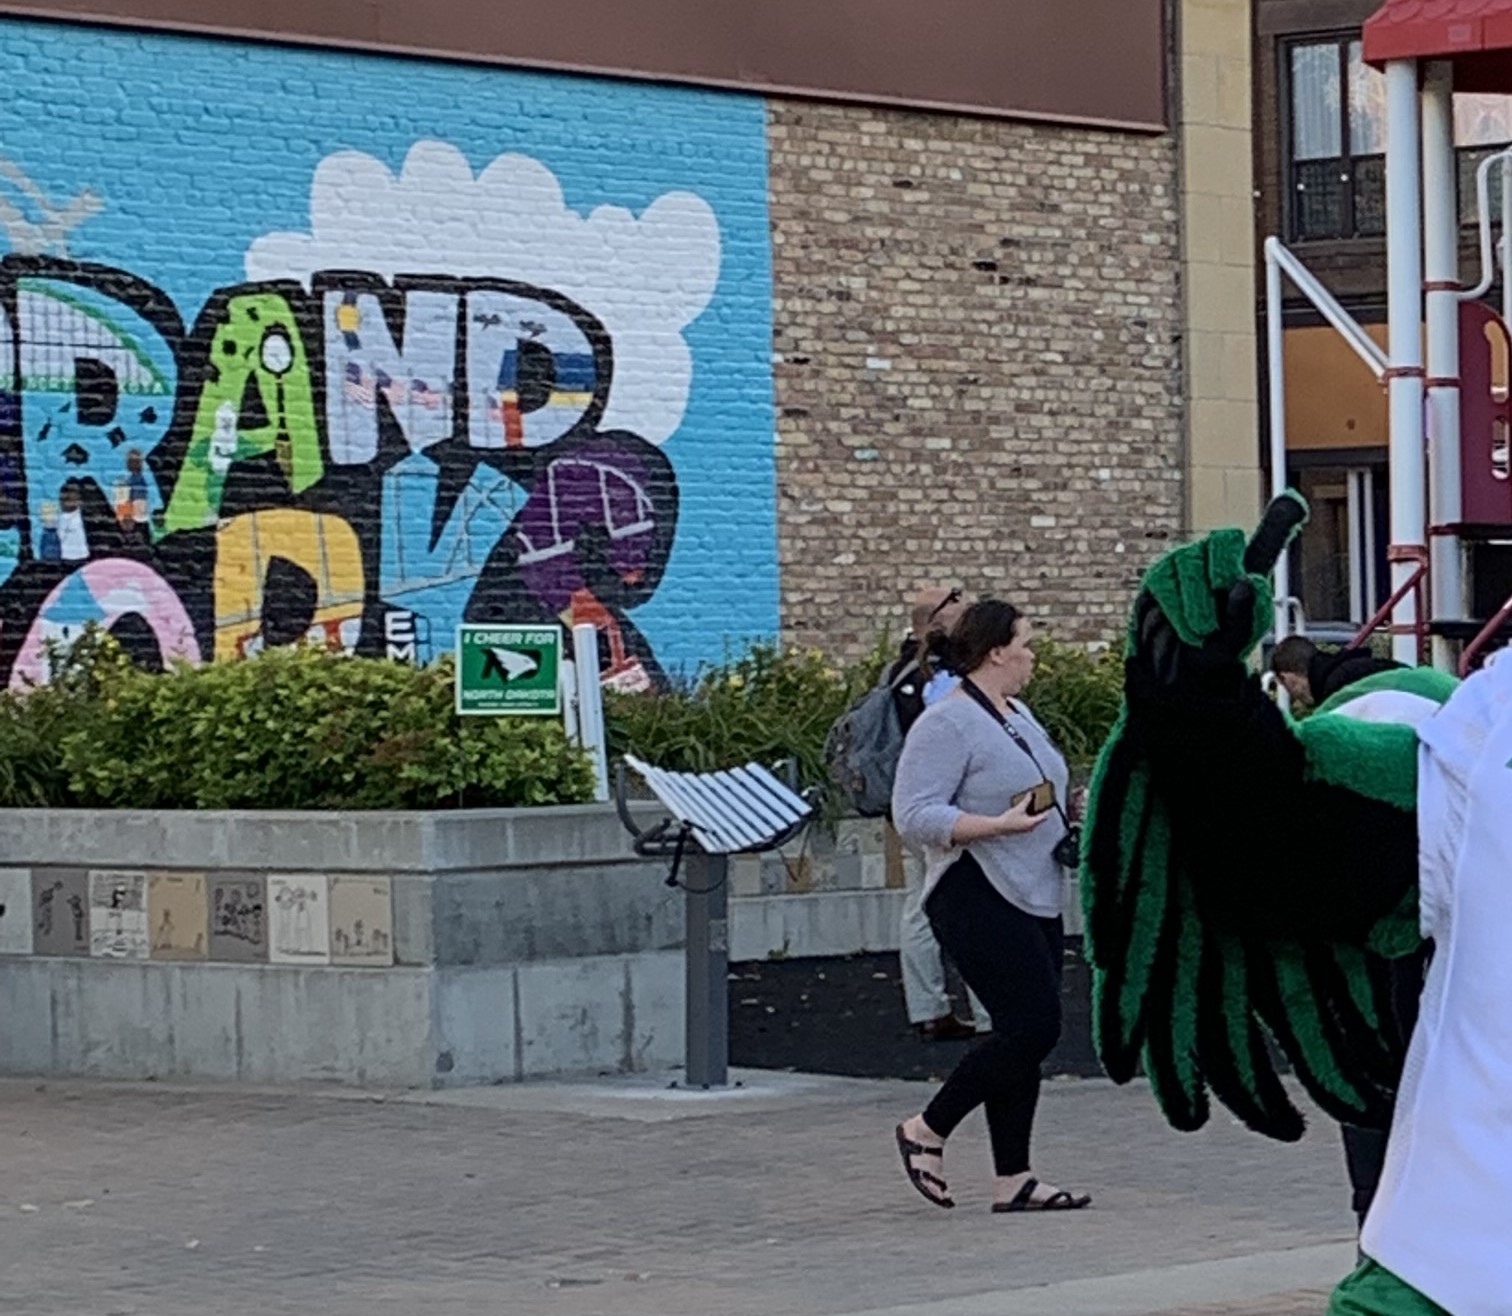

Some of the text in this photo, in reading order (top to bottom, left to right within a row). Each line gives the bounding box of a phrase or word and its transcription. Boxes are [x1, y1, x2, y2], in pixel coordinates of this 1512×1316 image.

[0, 254, 607, 560] RAND
[463, 632, 555, 645] I CHEER FOR
[463, 689, 556, 701] NORTH DAKOTA
